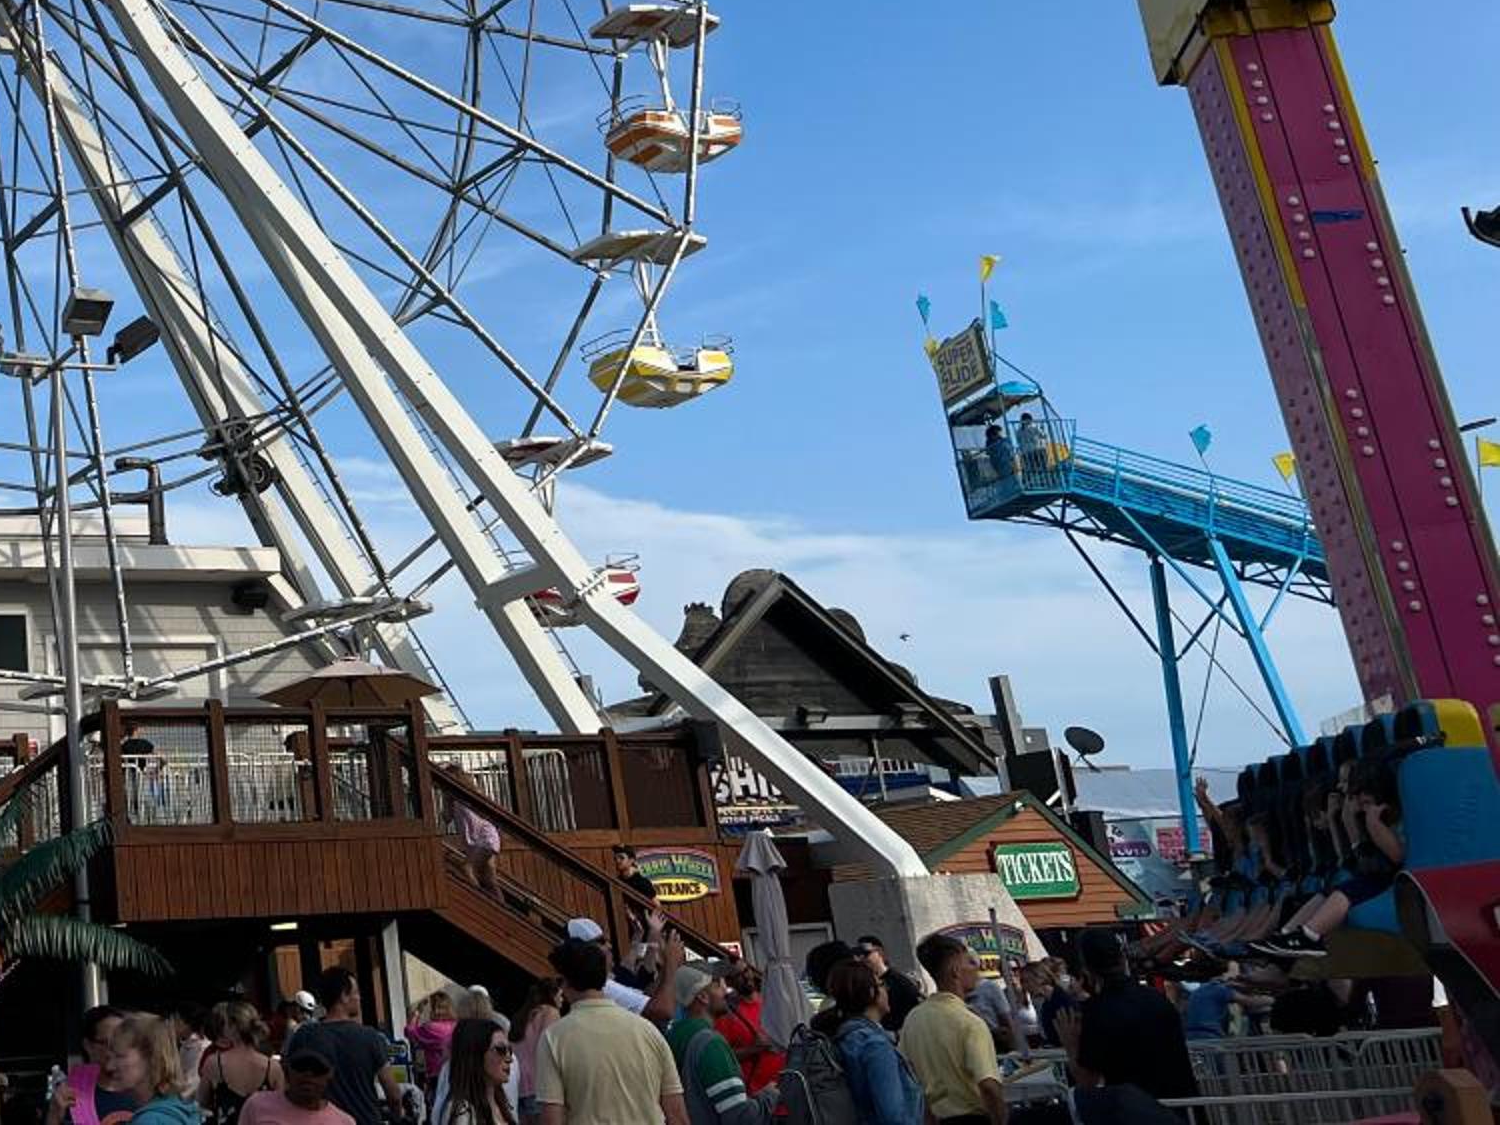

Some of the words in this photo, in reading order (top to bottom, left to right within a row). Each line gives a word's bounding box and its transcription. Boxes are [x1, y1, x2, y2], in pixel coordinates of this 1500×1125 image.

[937, 340, 976, 373] SUPER
[941, 359, 980, 384] SLIDE
[997, 849, 1075, 885] TICKETS
[653, 882, 701, 896] NTRANCE
